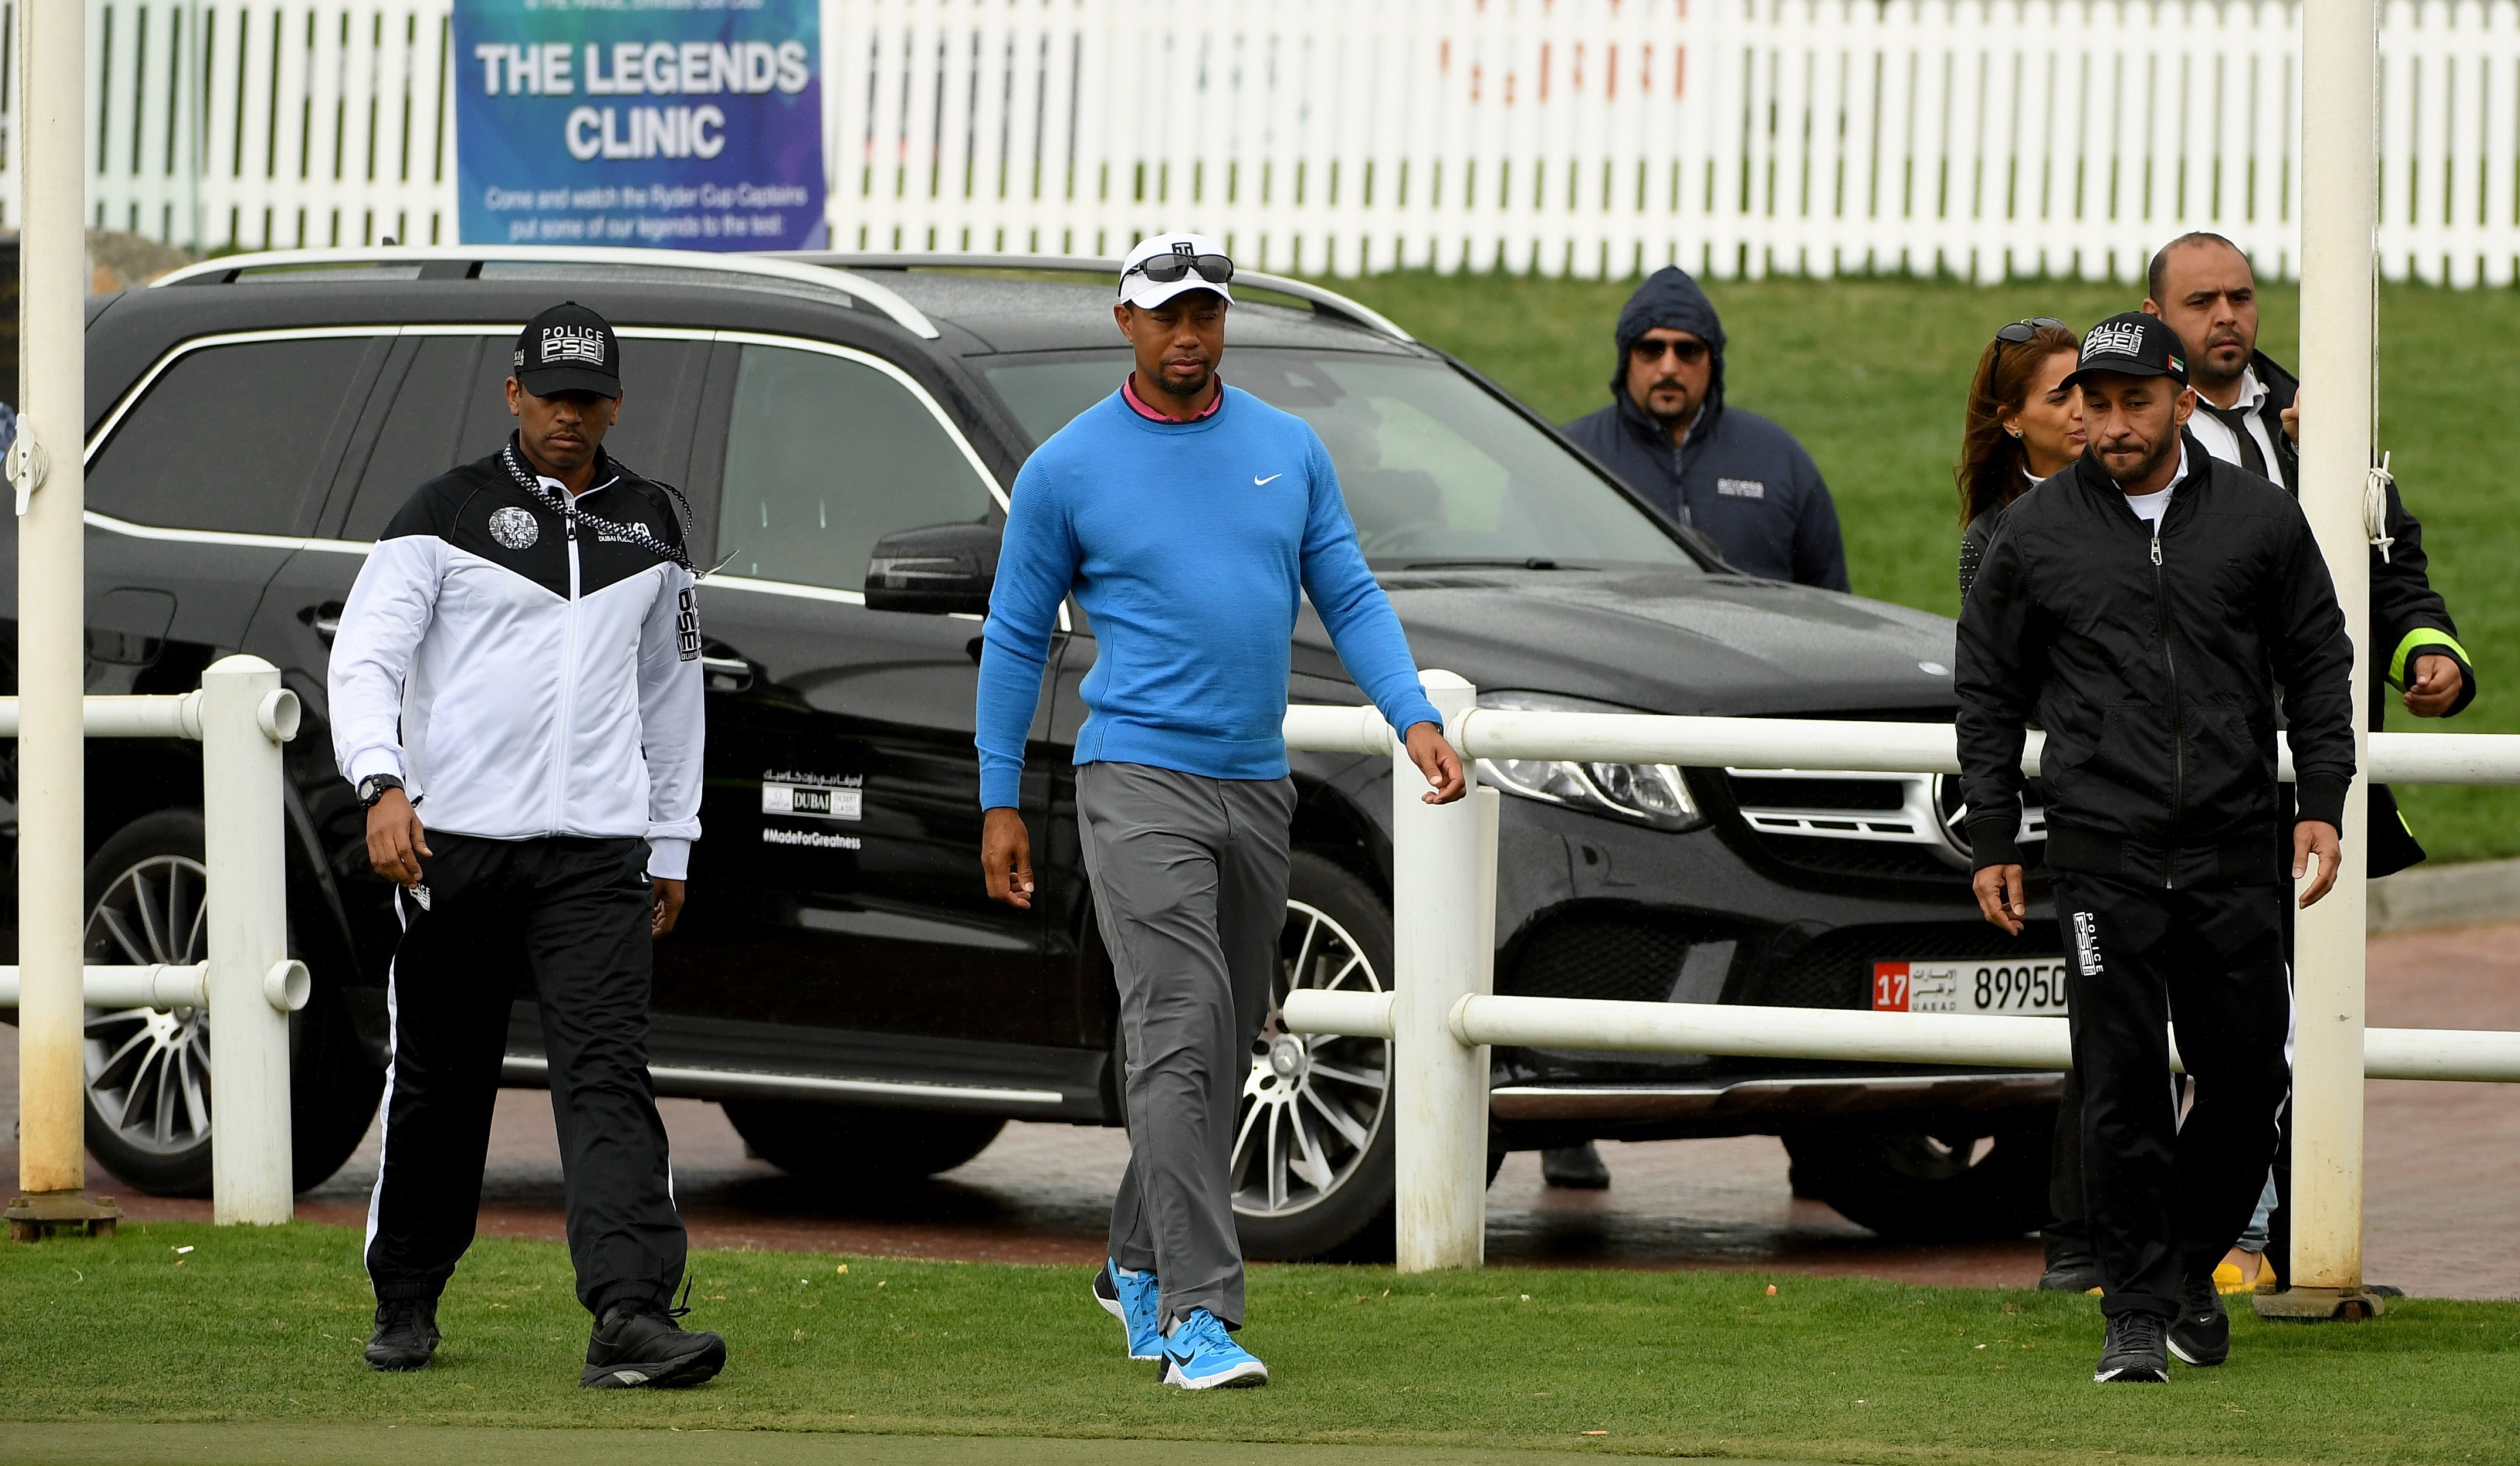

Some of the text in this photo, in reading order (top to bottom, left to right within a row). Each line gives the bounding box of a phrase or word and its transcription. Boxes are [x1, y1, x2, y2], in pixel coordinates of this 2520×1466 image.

[475, 41, 809, 96] THE LEGENDS
[565, 105, 725, 160] CLINIC
[486, 182, 808, 211] Come and watch the Ryder Cup Captains
[510, 218, 538, 242] put
[541, 220, 582, 236] some
[588, 216, 606, 236] of
[608, 220, 635, 237] our
[637, 215, 700, 241] legends
[703, 216, 720, 236] to
[723, 215, 747, 236] the
[543, 325, 604, 343] POLICE
[2085, 334, 2131, 356] PSE
[2087, 322, 2145, 341] POLICE
[544, 340, 595, 357] PSE
[678, 590, 696, 650] PSE
[794, 792, 829, 810] DUBAI
[2076, 915, 2092, 966] PSE
[2086, 912, 2104, 973] POLICE
[1877, 974, 1907, 1006] 17
[1975, 965, 2066, 1009] 89950
